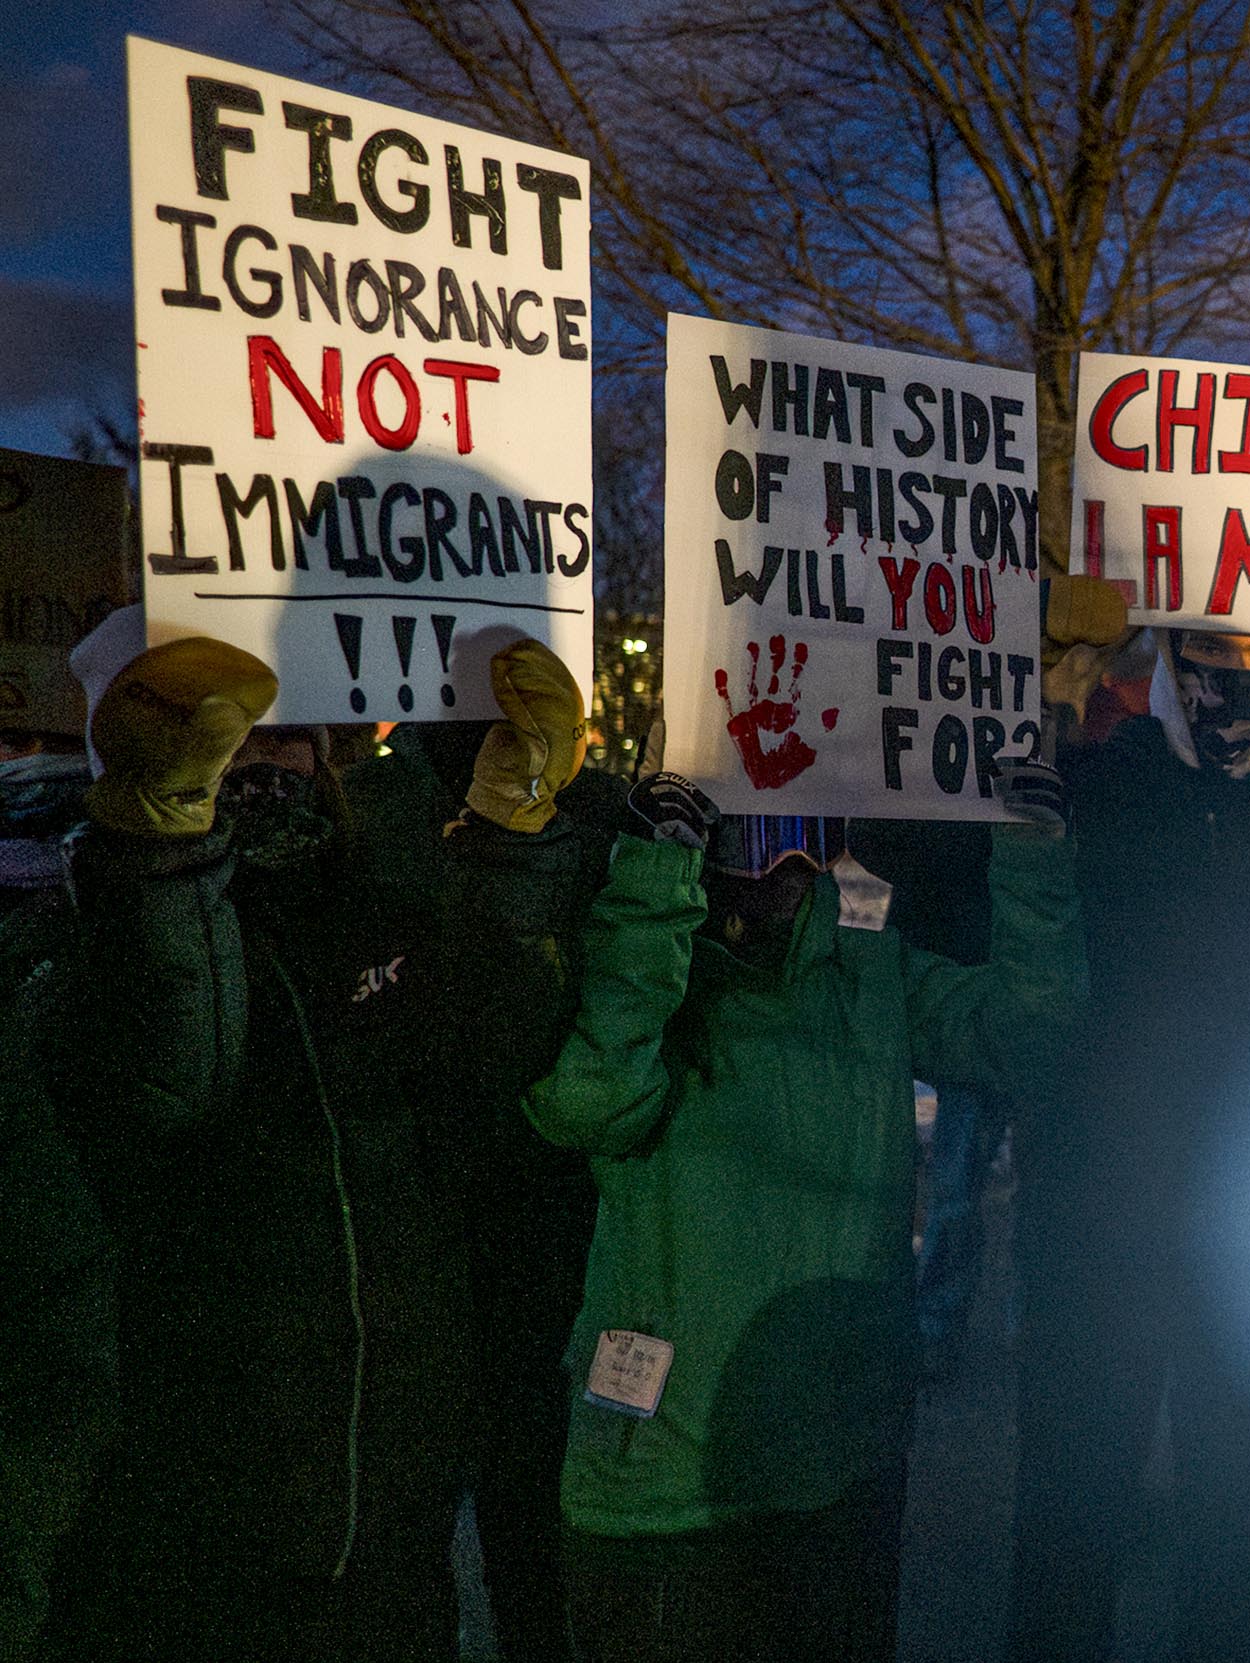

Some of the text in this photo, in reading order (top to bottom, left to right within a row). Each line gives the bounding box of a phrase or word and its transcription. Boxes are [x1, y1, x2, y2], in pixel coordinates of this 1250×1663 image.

[187, 75, 582, 271] FIGHT
[156, 204, 589, 361] IGNORANCE
[247, 335, 501, 455] NOT
[709, 354, 1025, 474] WHAT SIDE
[142, 442, 591, 583] IMMIGRANTS
[714, 449, 1039, 572] OF HISTORY
[1083, 499, 1183, 613] LA
[714, 538, 997, 645] WILL YOU
[876, 637, 1035, 712] FIGHT
[881, 705, 1041, 799] FOR?
